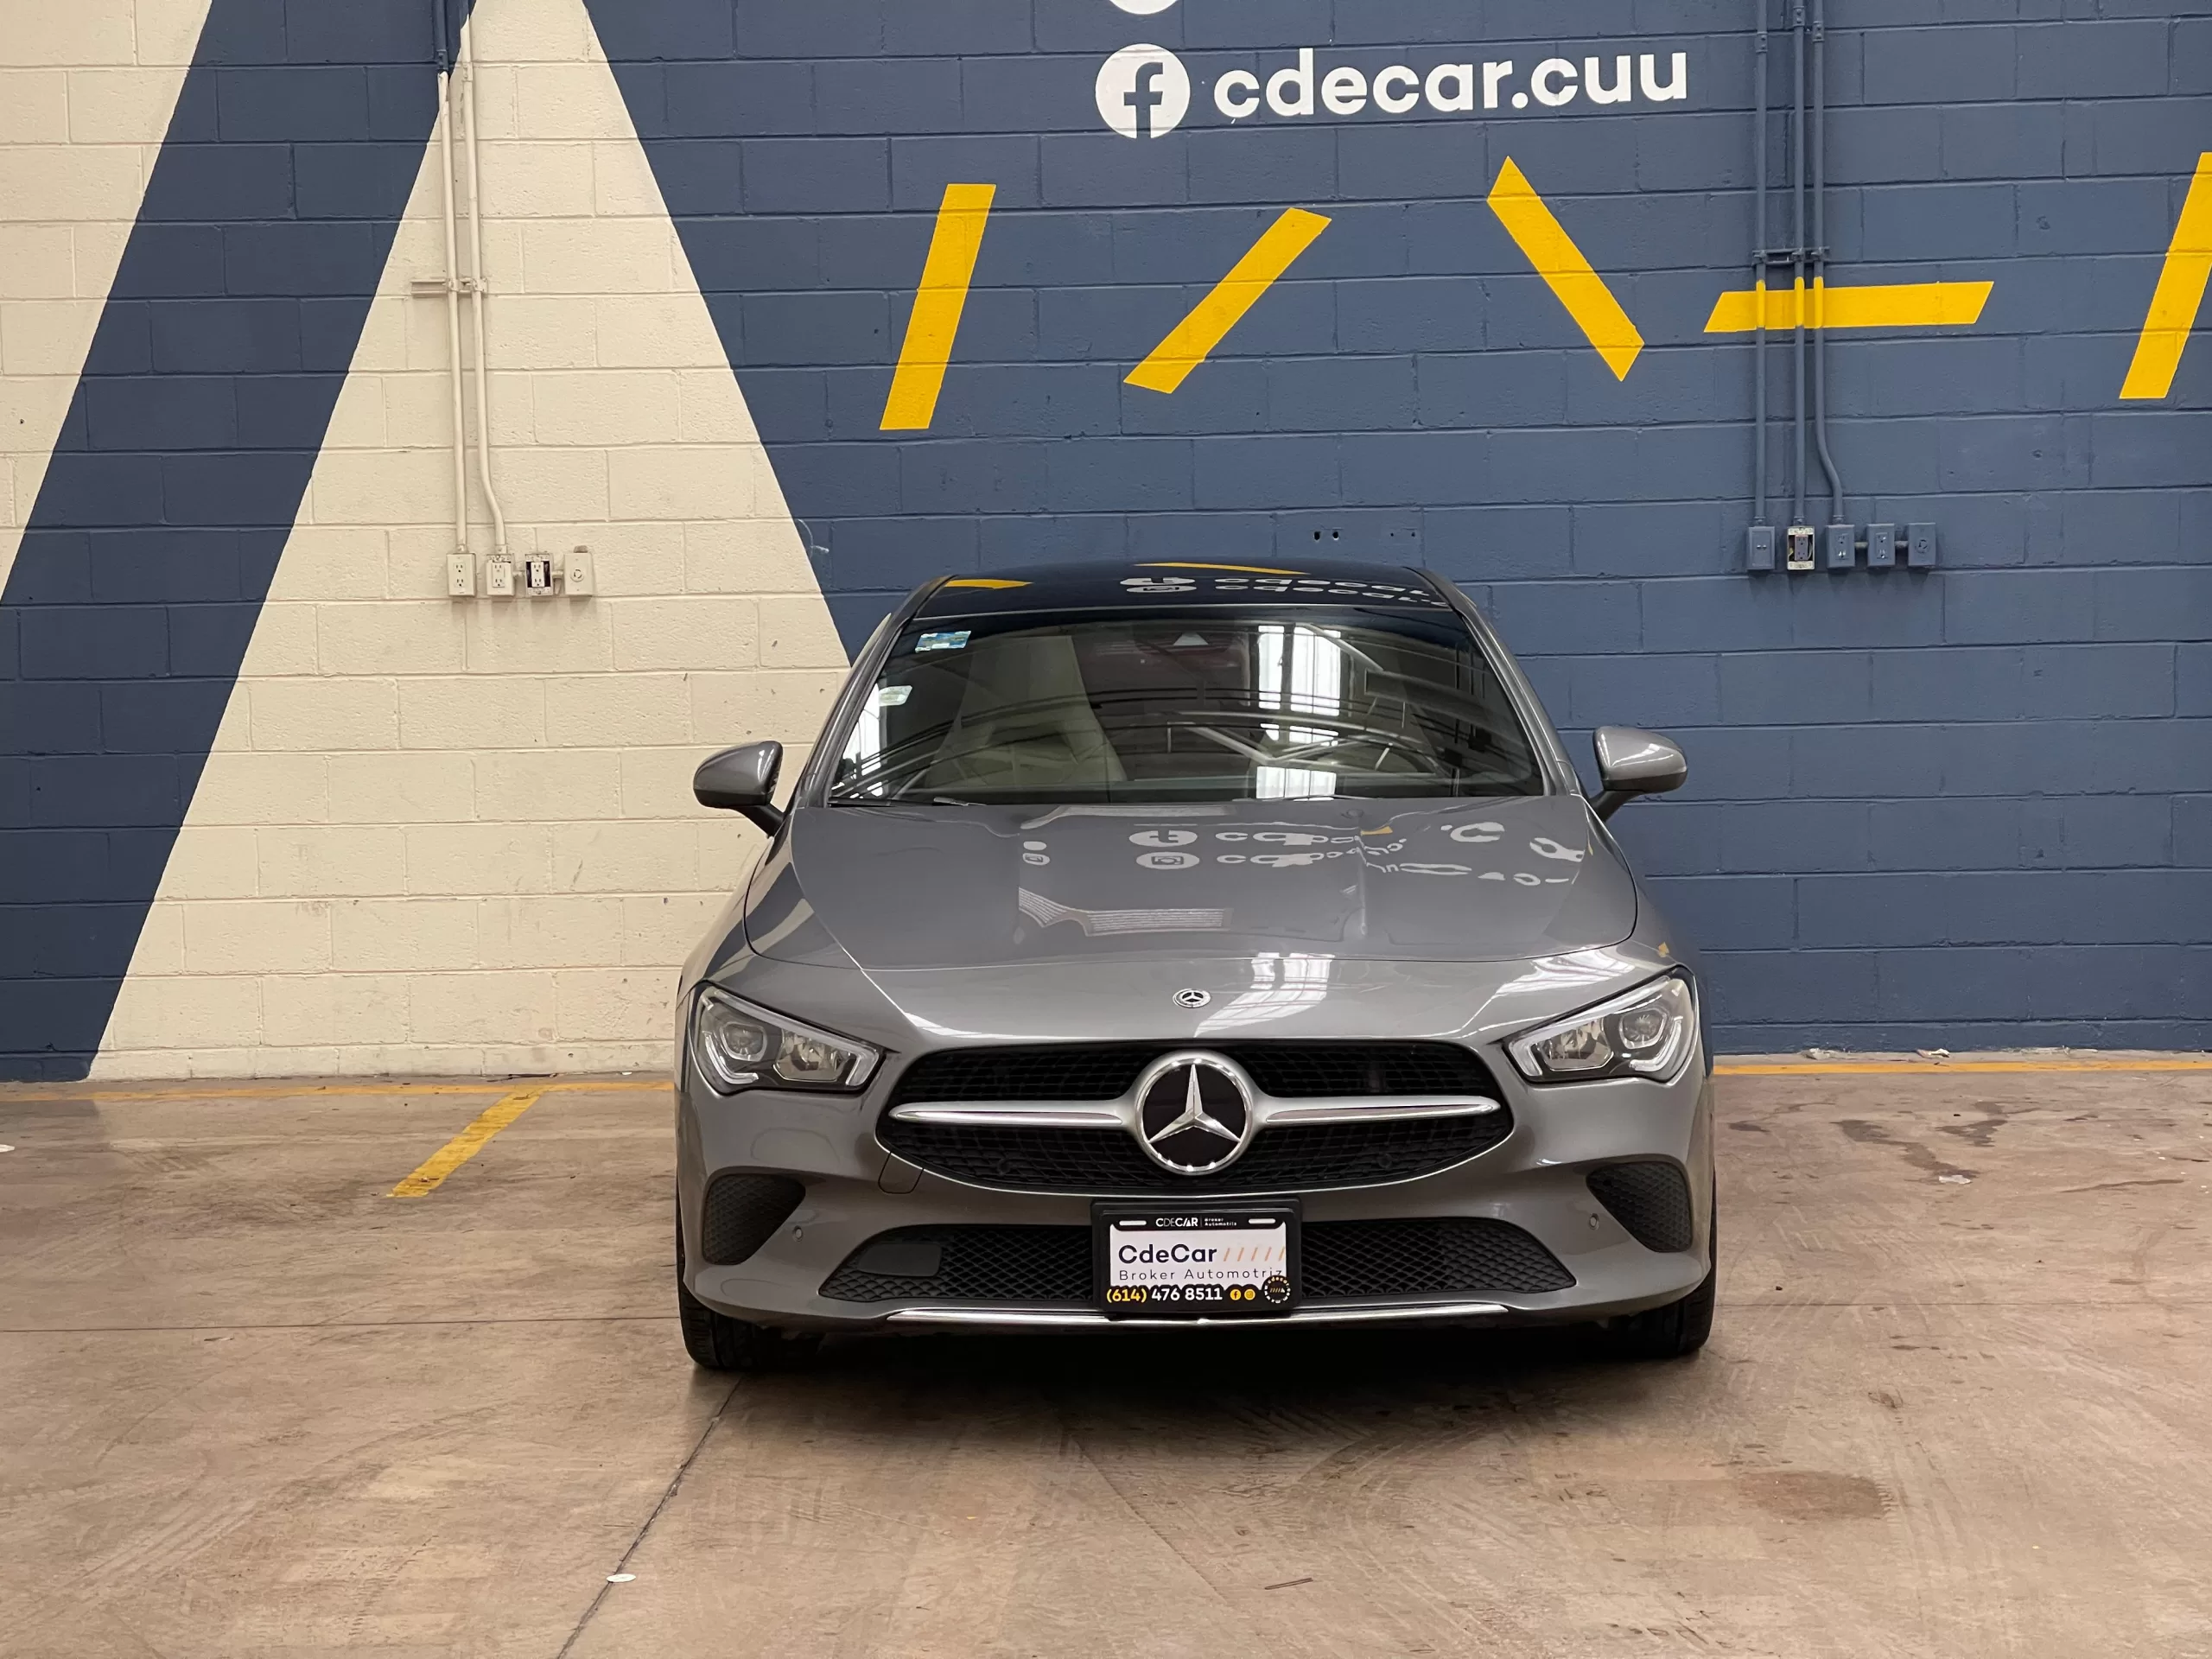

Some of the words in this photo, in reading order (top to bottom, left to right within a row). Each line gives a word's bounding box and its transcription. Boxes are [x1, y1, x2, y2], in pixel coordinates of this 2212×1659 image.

[1214, 48, 1687, 118] cdecar.cuu
[1118, 1243, 1217, 1264] CdeCar
[1119, 1269, 1175, 1281] Broker
[1106, 1288, 1147, 1303] (614)
[1151, 1287, 1180, 1301] 476
[1185, 1287, 1224, 1301] 8511
